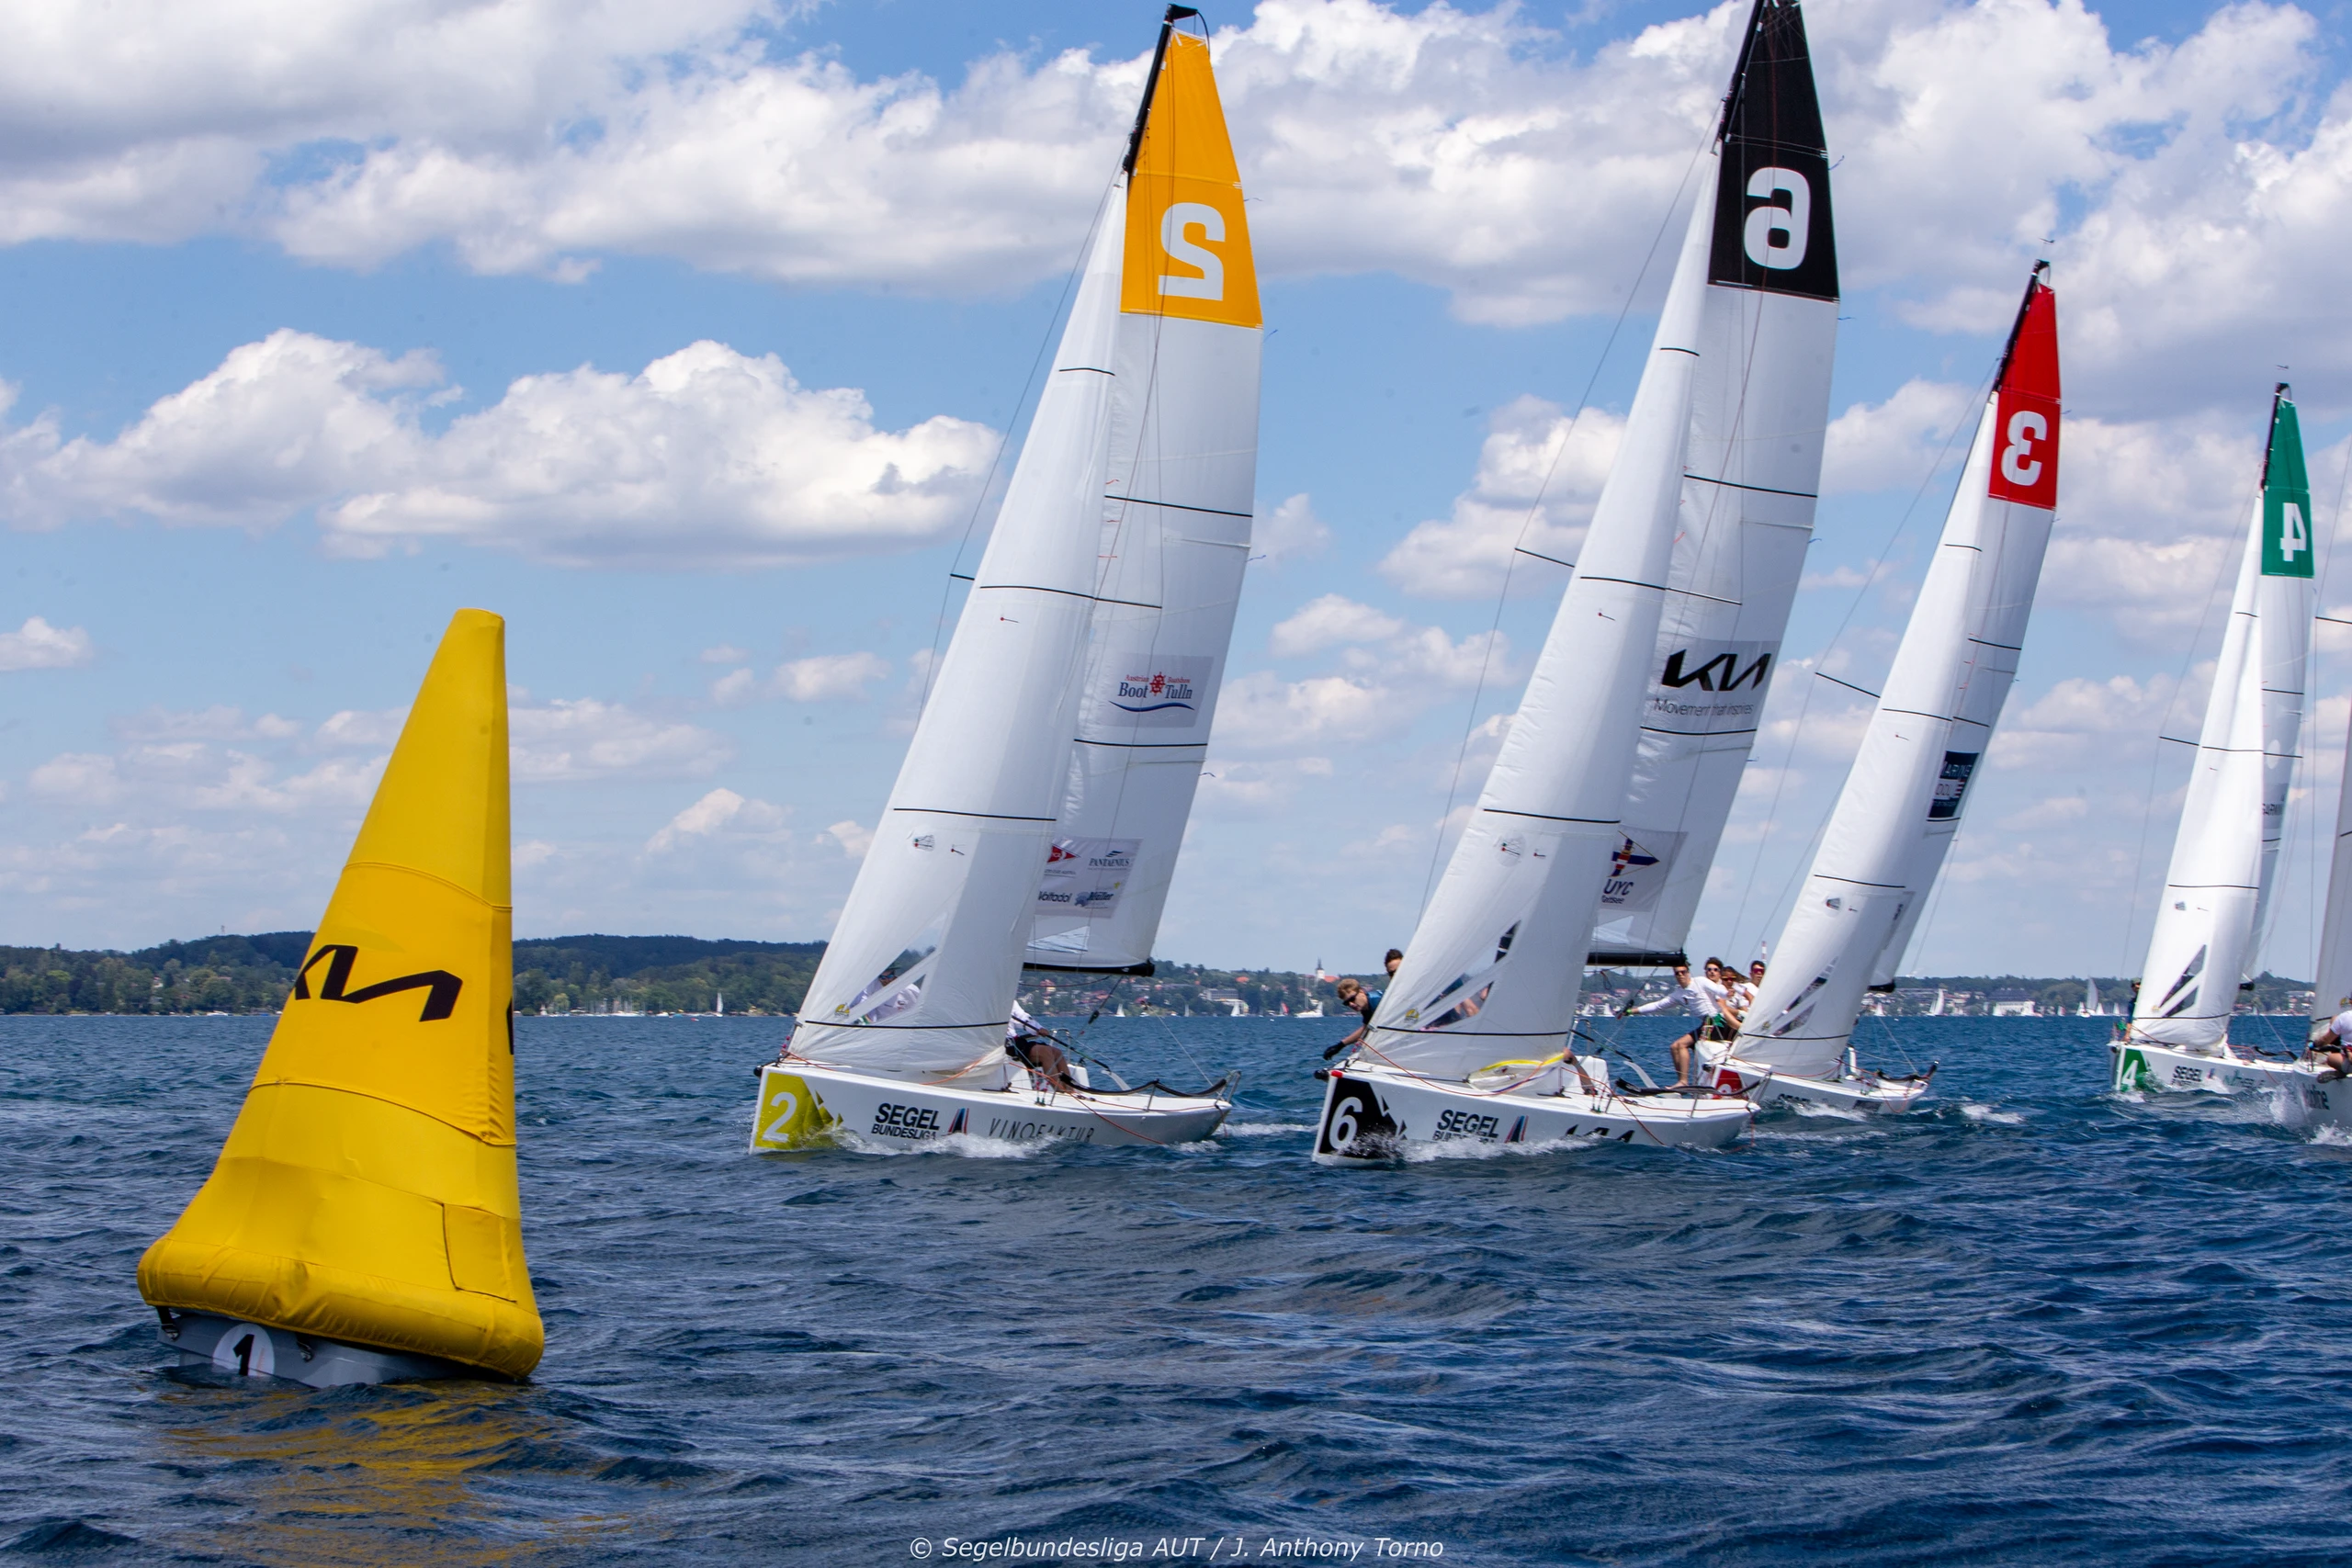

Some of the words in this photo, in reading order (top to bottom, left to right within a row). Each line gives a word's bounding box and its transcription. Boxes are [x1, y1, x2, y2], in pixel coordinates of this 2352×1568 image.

[1661, 649, 1771, 692] KIA
[1117, 682, 1148, 698] Boot
[1164, 683, 1193, 699] Tulln
[1654, 697, 1711, 716] Movement
[1603, 878, 1634, 896] UYC
[2121, 1059, 2139, 1087] 4
[762, 1091, 798, 1143] 2
[875, 1102, 941, 1131] SEGEL
[1329, 1096, 1364, 1148] 6
[1437, 1109, 1499, 1139] SEGEL
[871, 1122, 937, 1141] BUNDESLIGA
[232, 1334, 255, 1377] 1
